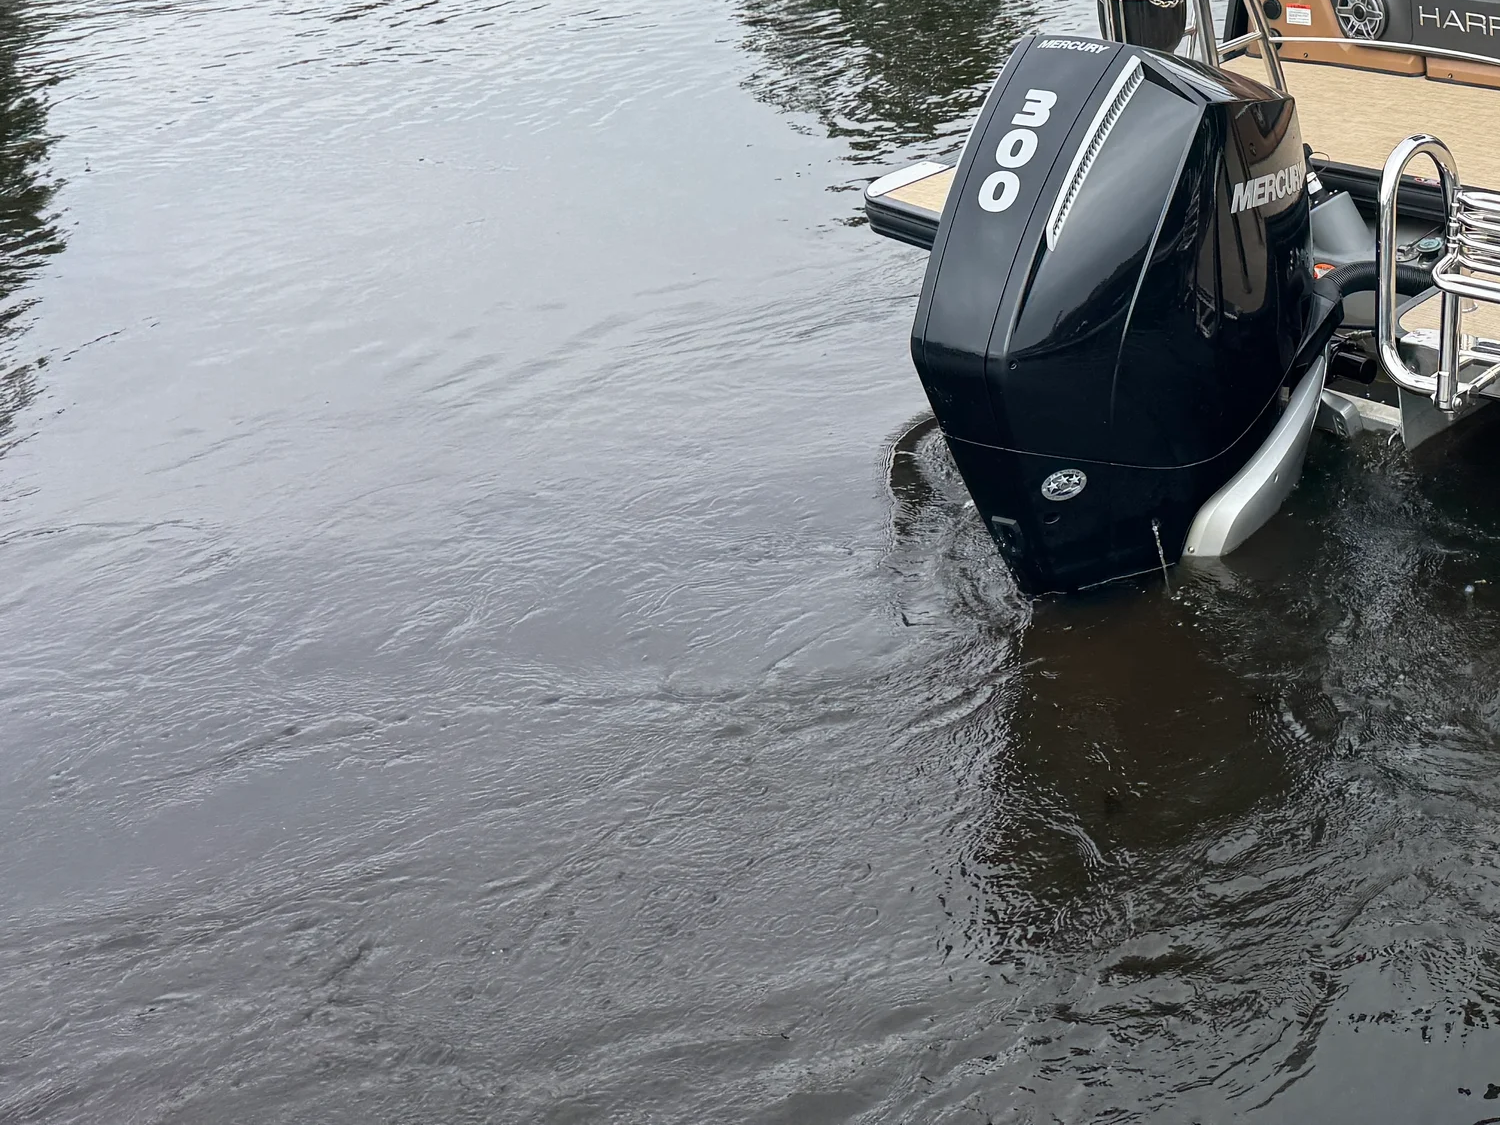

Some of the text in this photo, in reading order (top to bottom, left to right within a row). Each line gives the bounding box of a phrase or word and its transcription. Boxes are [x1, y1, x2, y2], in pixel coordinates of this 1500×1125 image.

[1037, 39, 1110, 54] MERCURY
[978, 88, 1058, 213] 300
[1230, 161, 1304, 214] MERCURY
